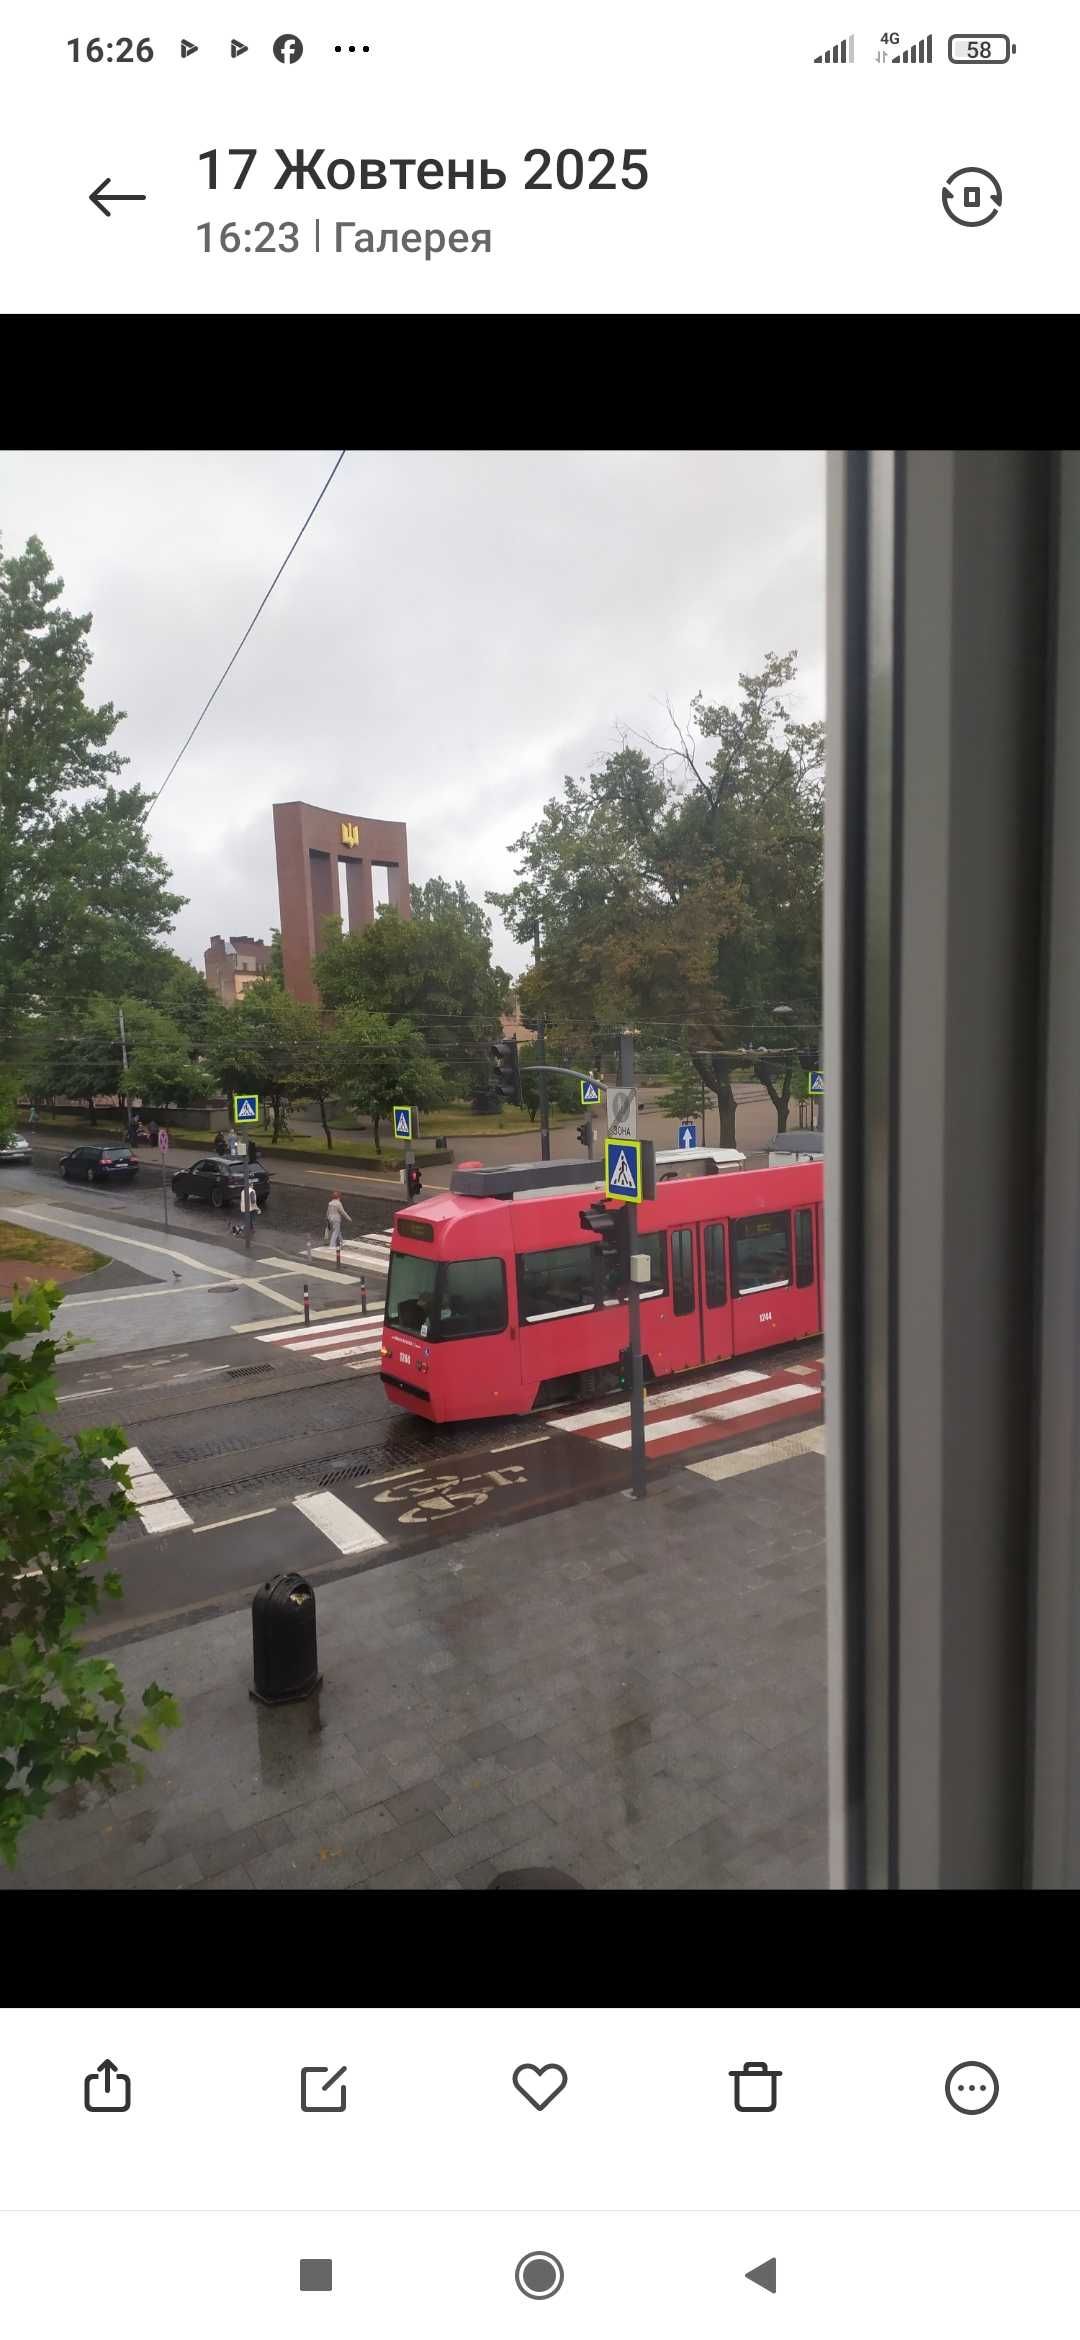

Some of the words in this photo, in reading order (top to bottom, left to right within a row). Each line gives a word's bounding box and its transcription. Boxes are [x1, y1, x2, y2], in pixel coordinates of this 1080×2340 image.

[68, 38, 153, 63] 16:26
[880, 32, 900, 45] 4G
[967, 41, 992, 59] 58
[199, 149, 257, 190] 17
[273, 149, 507, 190] Жовтень
[523, 149, 649, 190] 2025
[197, 221, 299, 253] 16:23
[335, 221, 491, 261] Галерея
